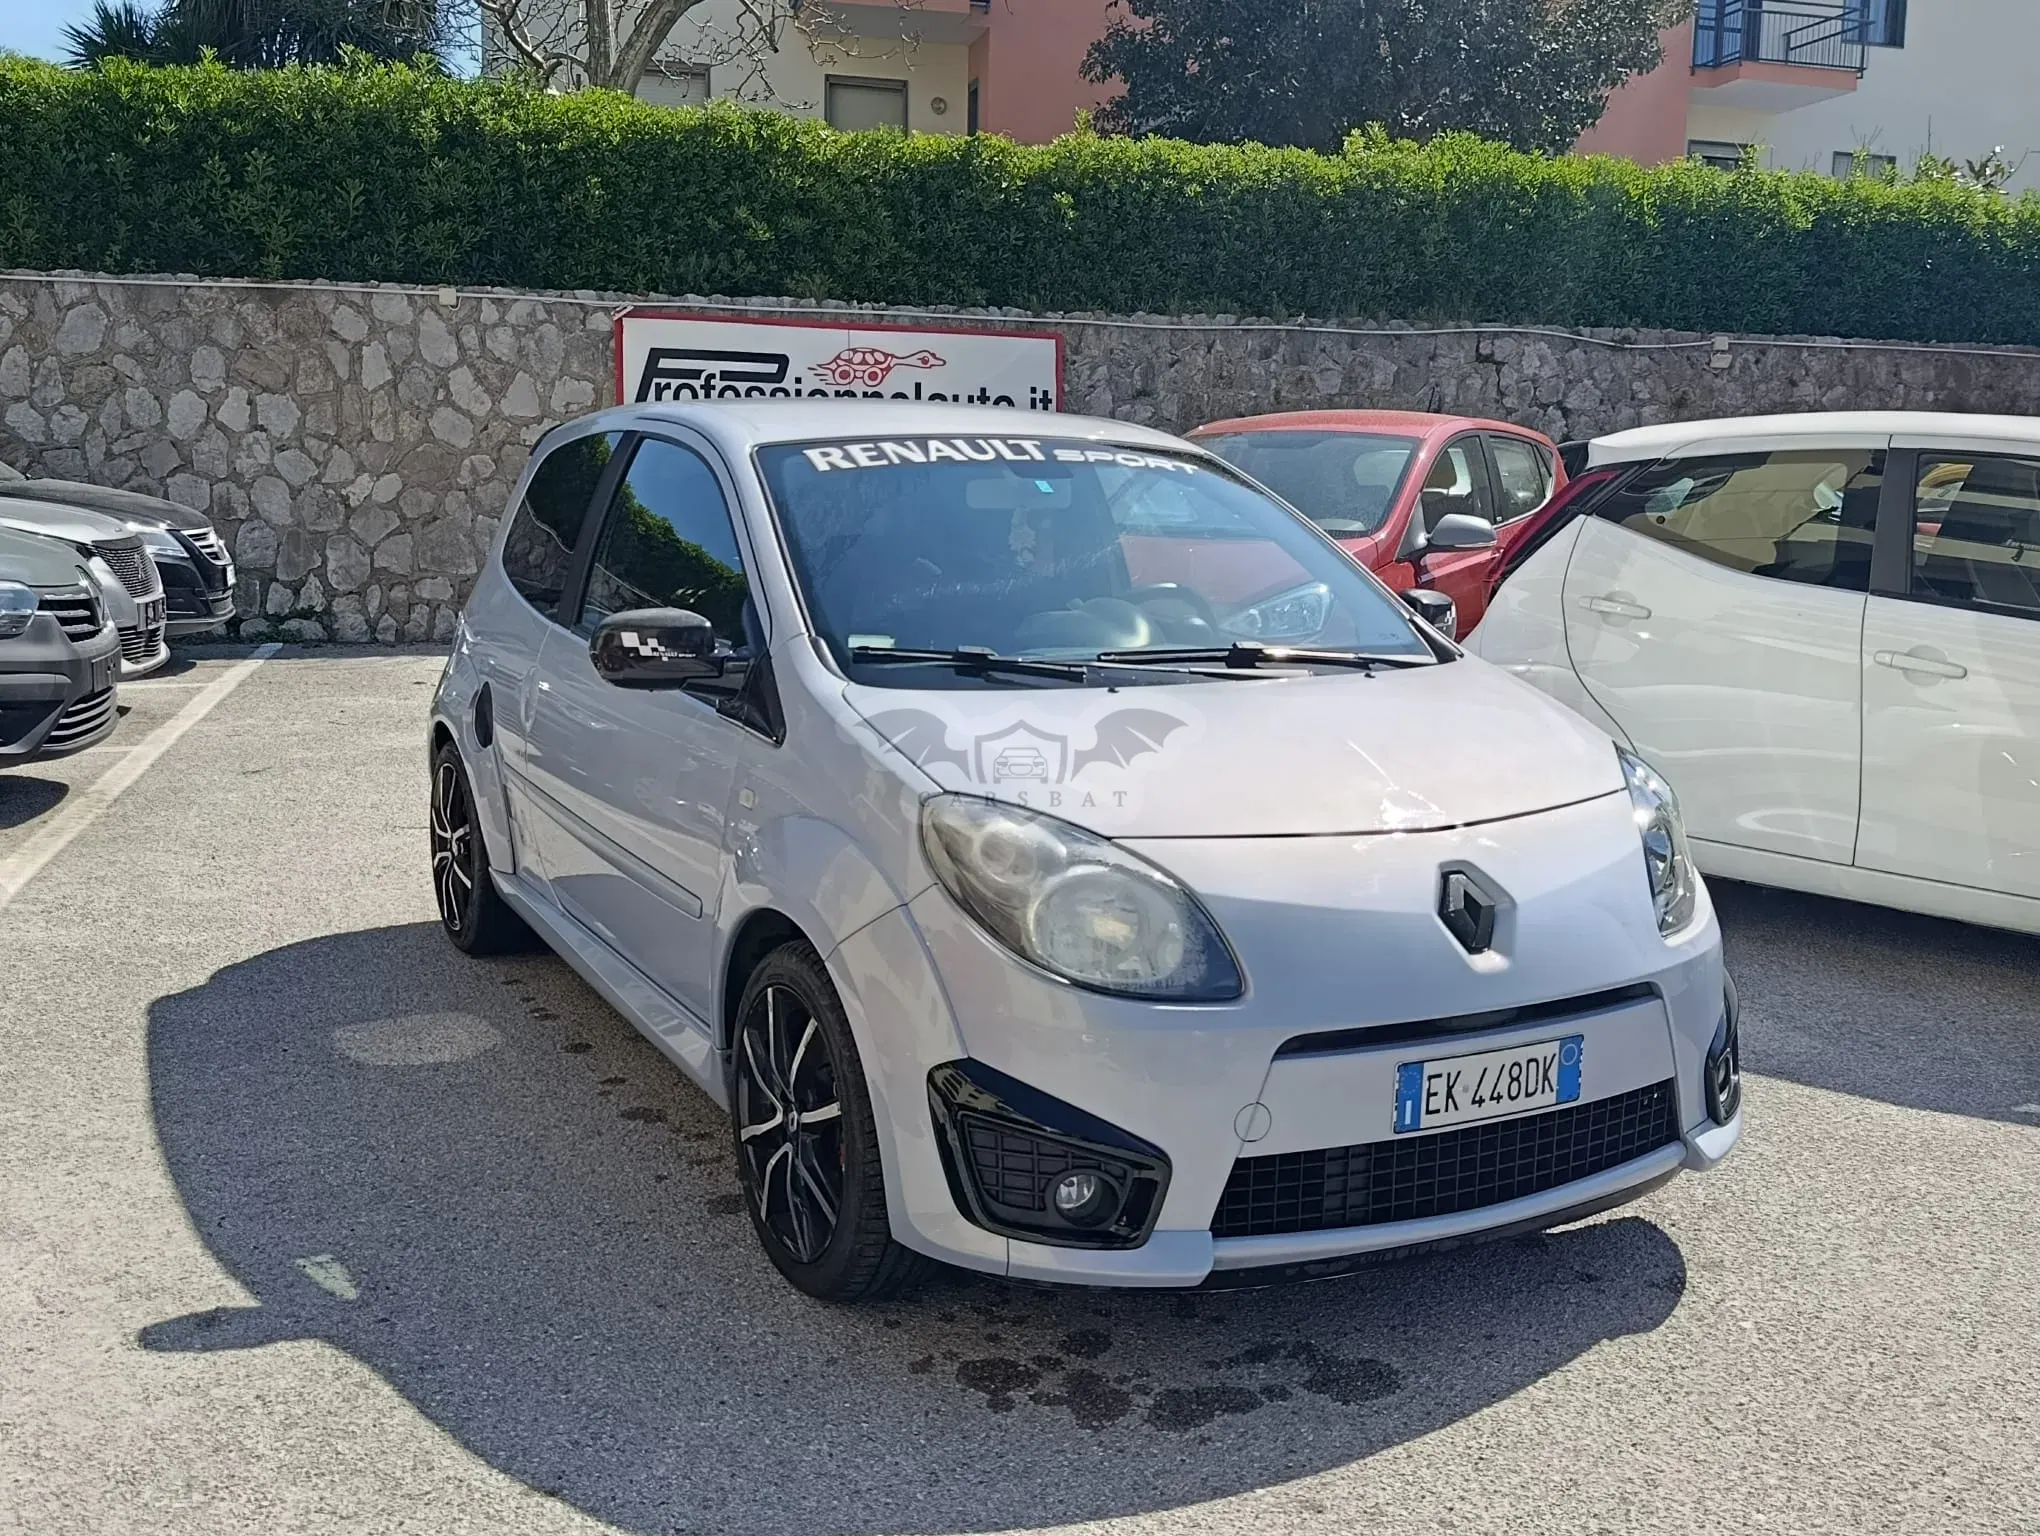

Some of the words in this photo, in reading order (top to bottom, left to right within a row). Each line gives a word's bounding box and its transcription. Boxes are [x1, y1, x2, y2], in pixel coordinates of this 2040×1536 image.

[802, 439, 1046, 472] RENAULT
[1052, 449, 1199, 474] SPORT
[1425, 1070, 1462, 1115] EK
[1471, 1053, 1557, 1109] 448DK
